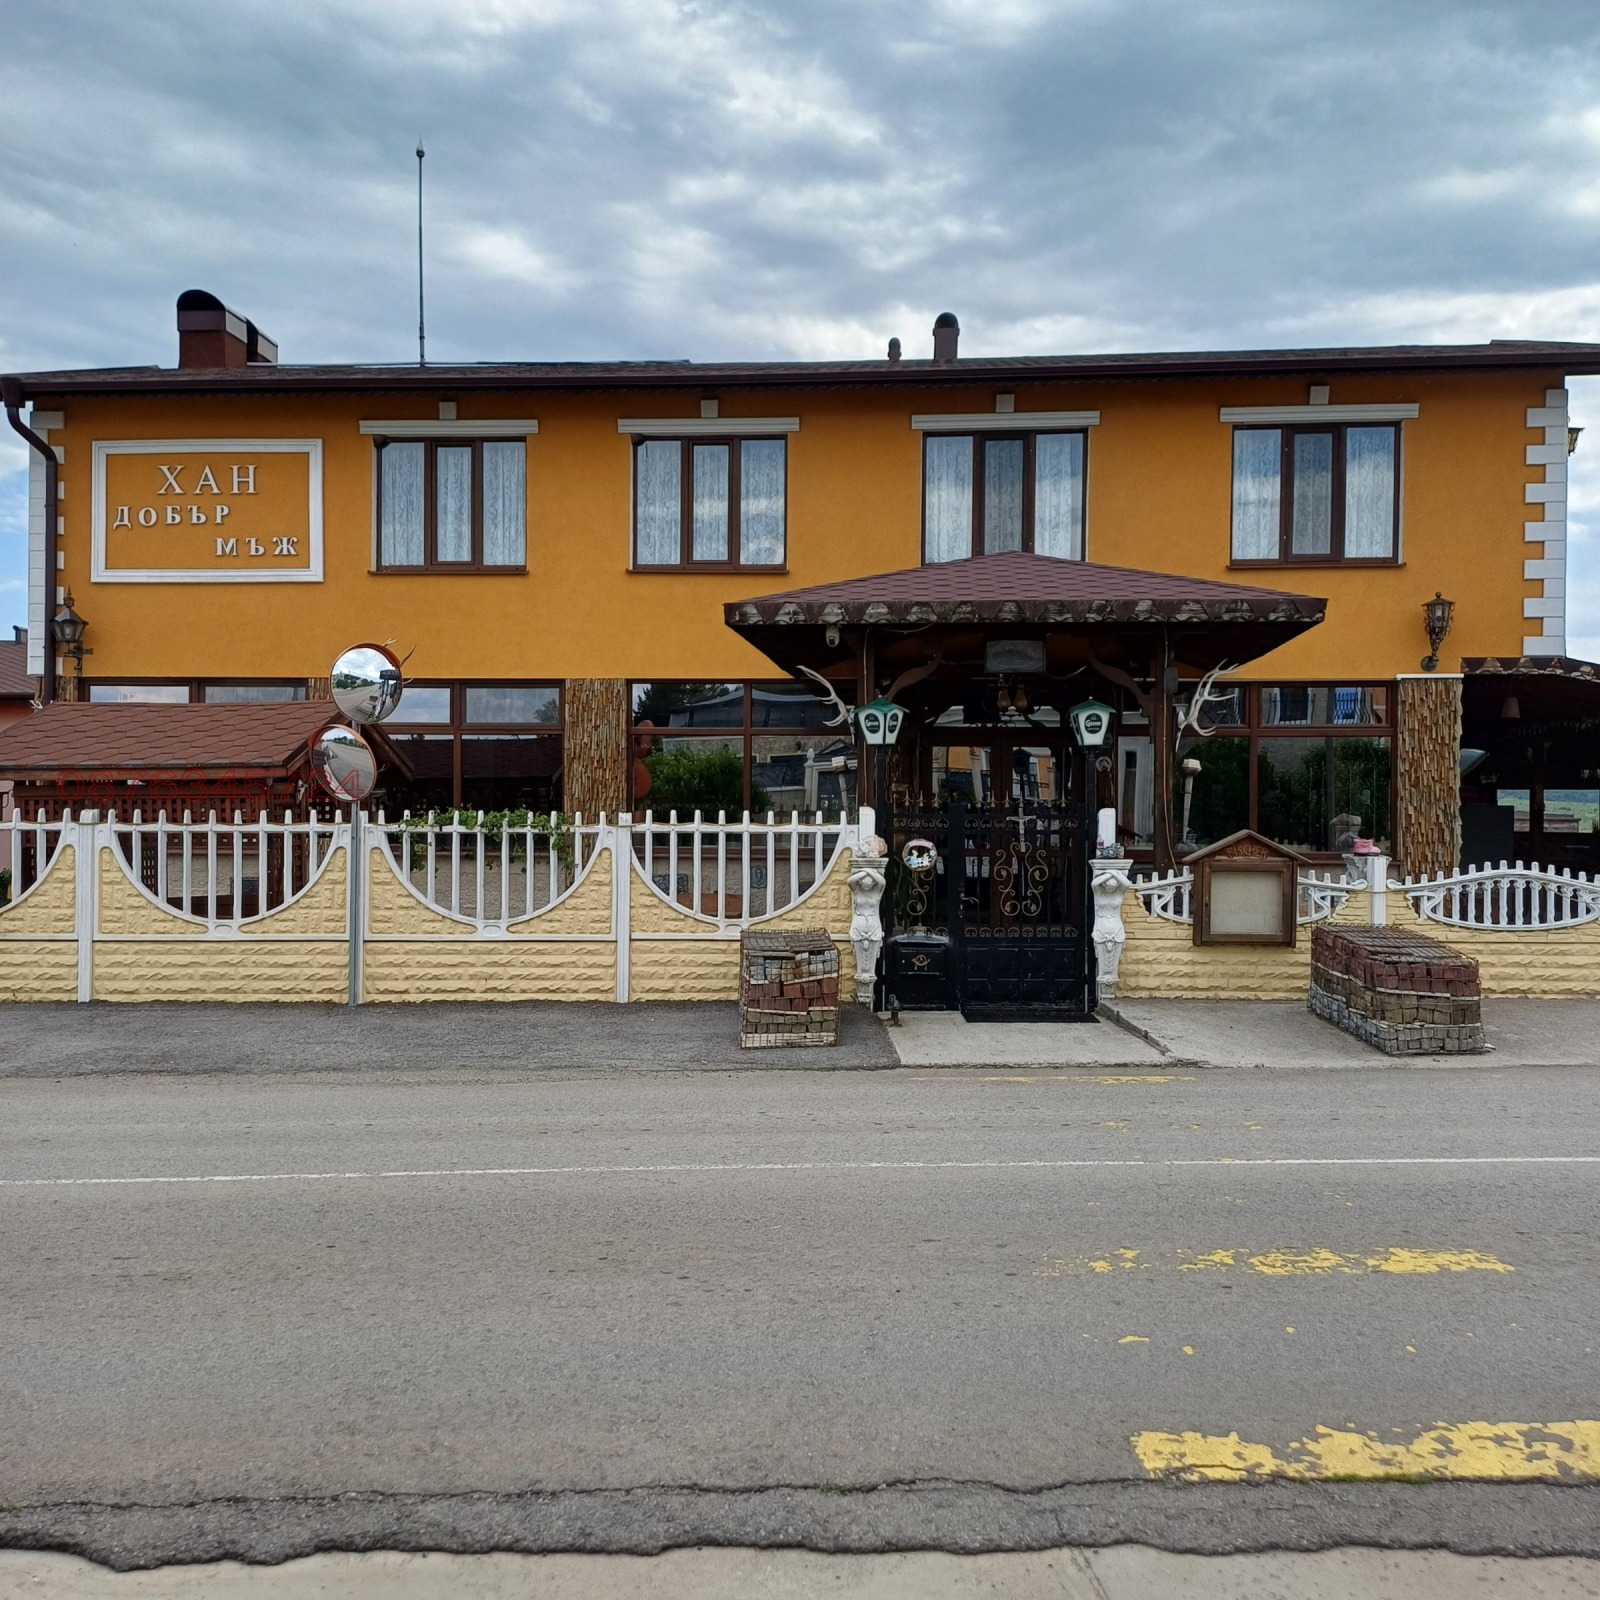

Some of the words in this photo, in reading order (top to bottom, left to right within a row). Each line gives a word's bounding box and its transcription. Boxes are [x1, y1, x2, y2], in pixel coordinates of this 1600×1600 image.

[157, 464, 258, 494] ХАН
[113, 504, 230, 530] ДОБЪР
[215, 536, 298, 556] МЪЖ
